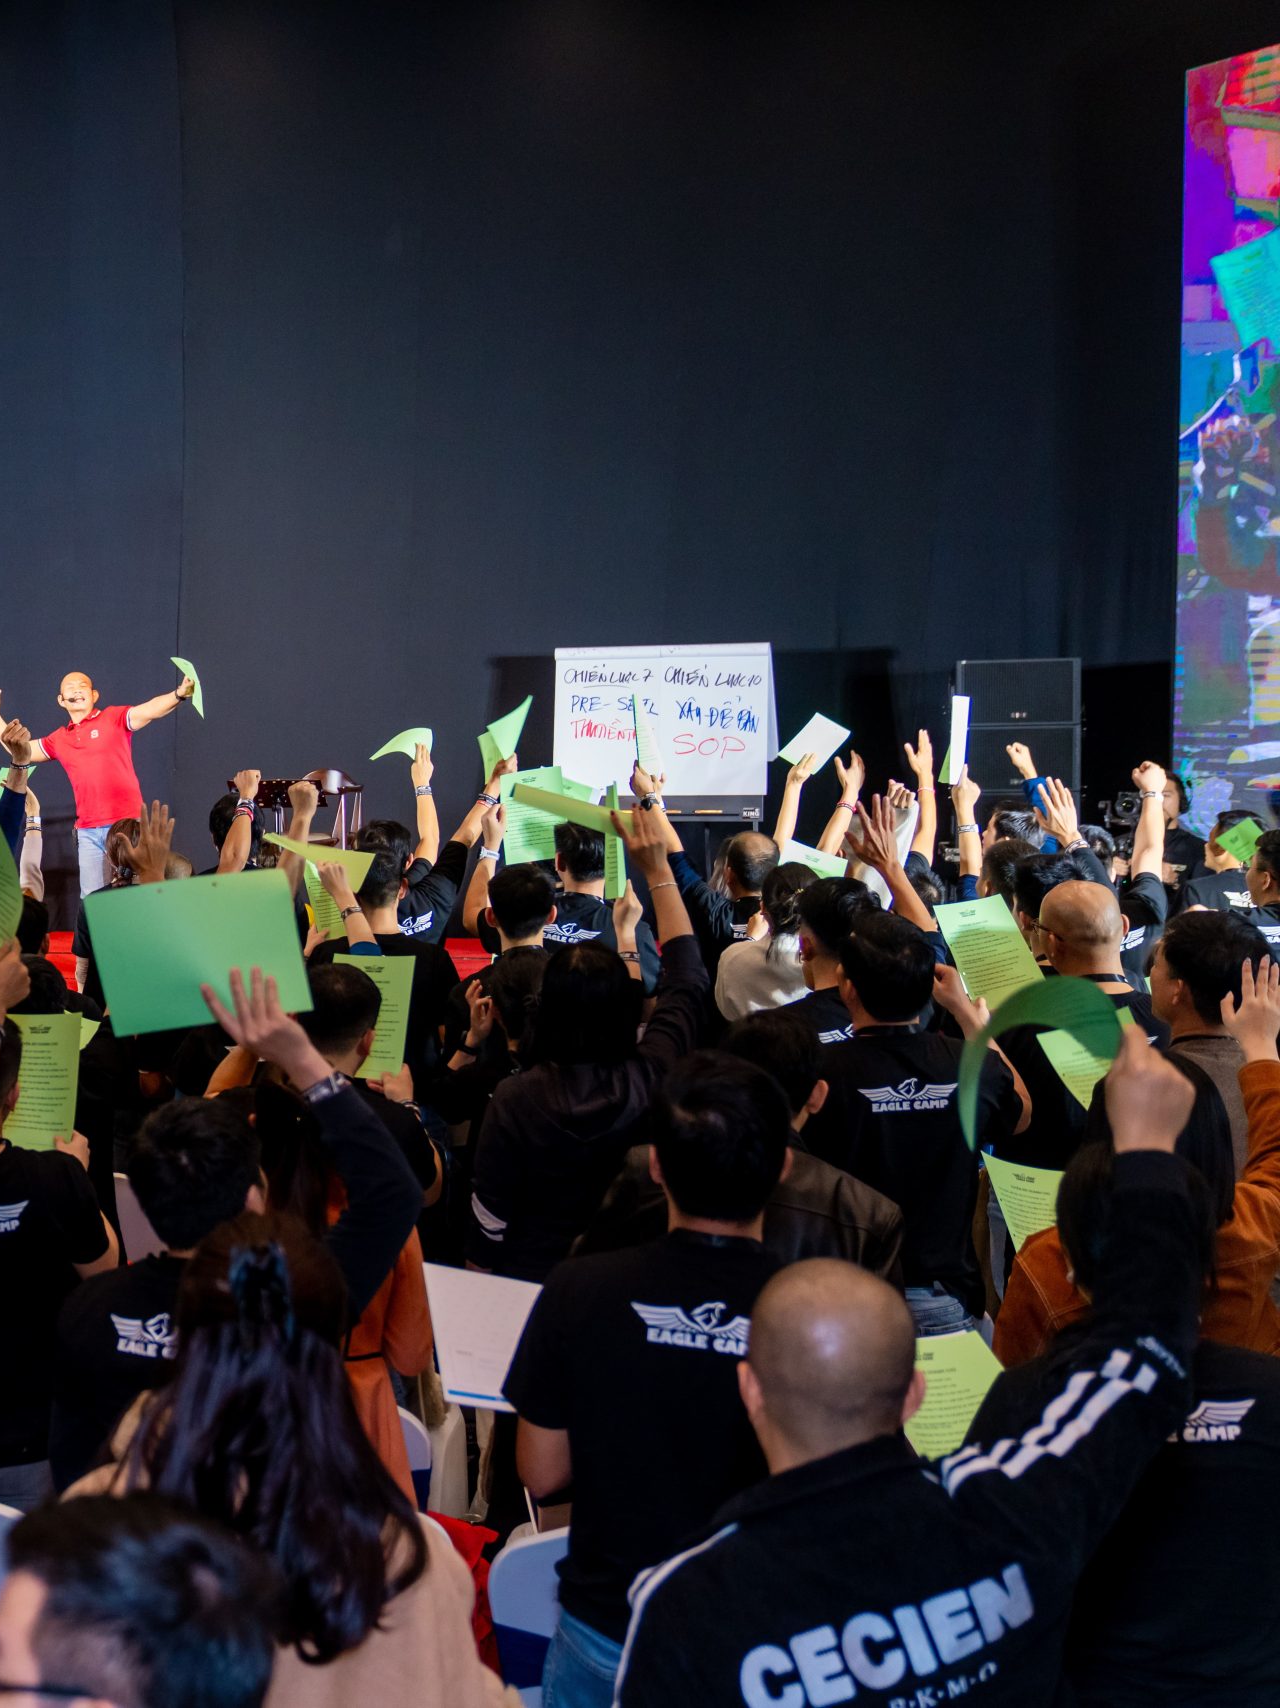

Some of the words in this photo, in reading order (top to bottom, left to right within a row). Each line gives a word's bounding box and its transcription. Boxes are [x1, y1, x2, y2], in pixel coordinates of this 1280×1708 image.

[672, 733, 747, 759] SOP
[871, 1102, 911, 1113] EAGLE
[913, 1099, 949, 1110] CAMP
[116, 1337, 158, 1359] EAGLE
[646, 1327, 709, 1350] EAGLE
[1182, 1425, 1242, 1443] CAMP
[739, 1562, 1035, 1708] CECIEN
